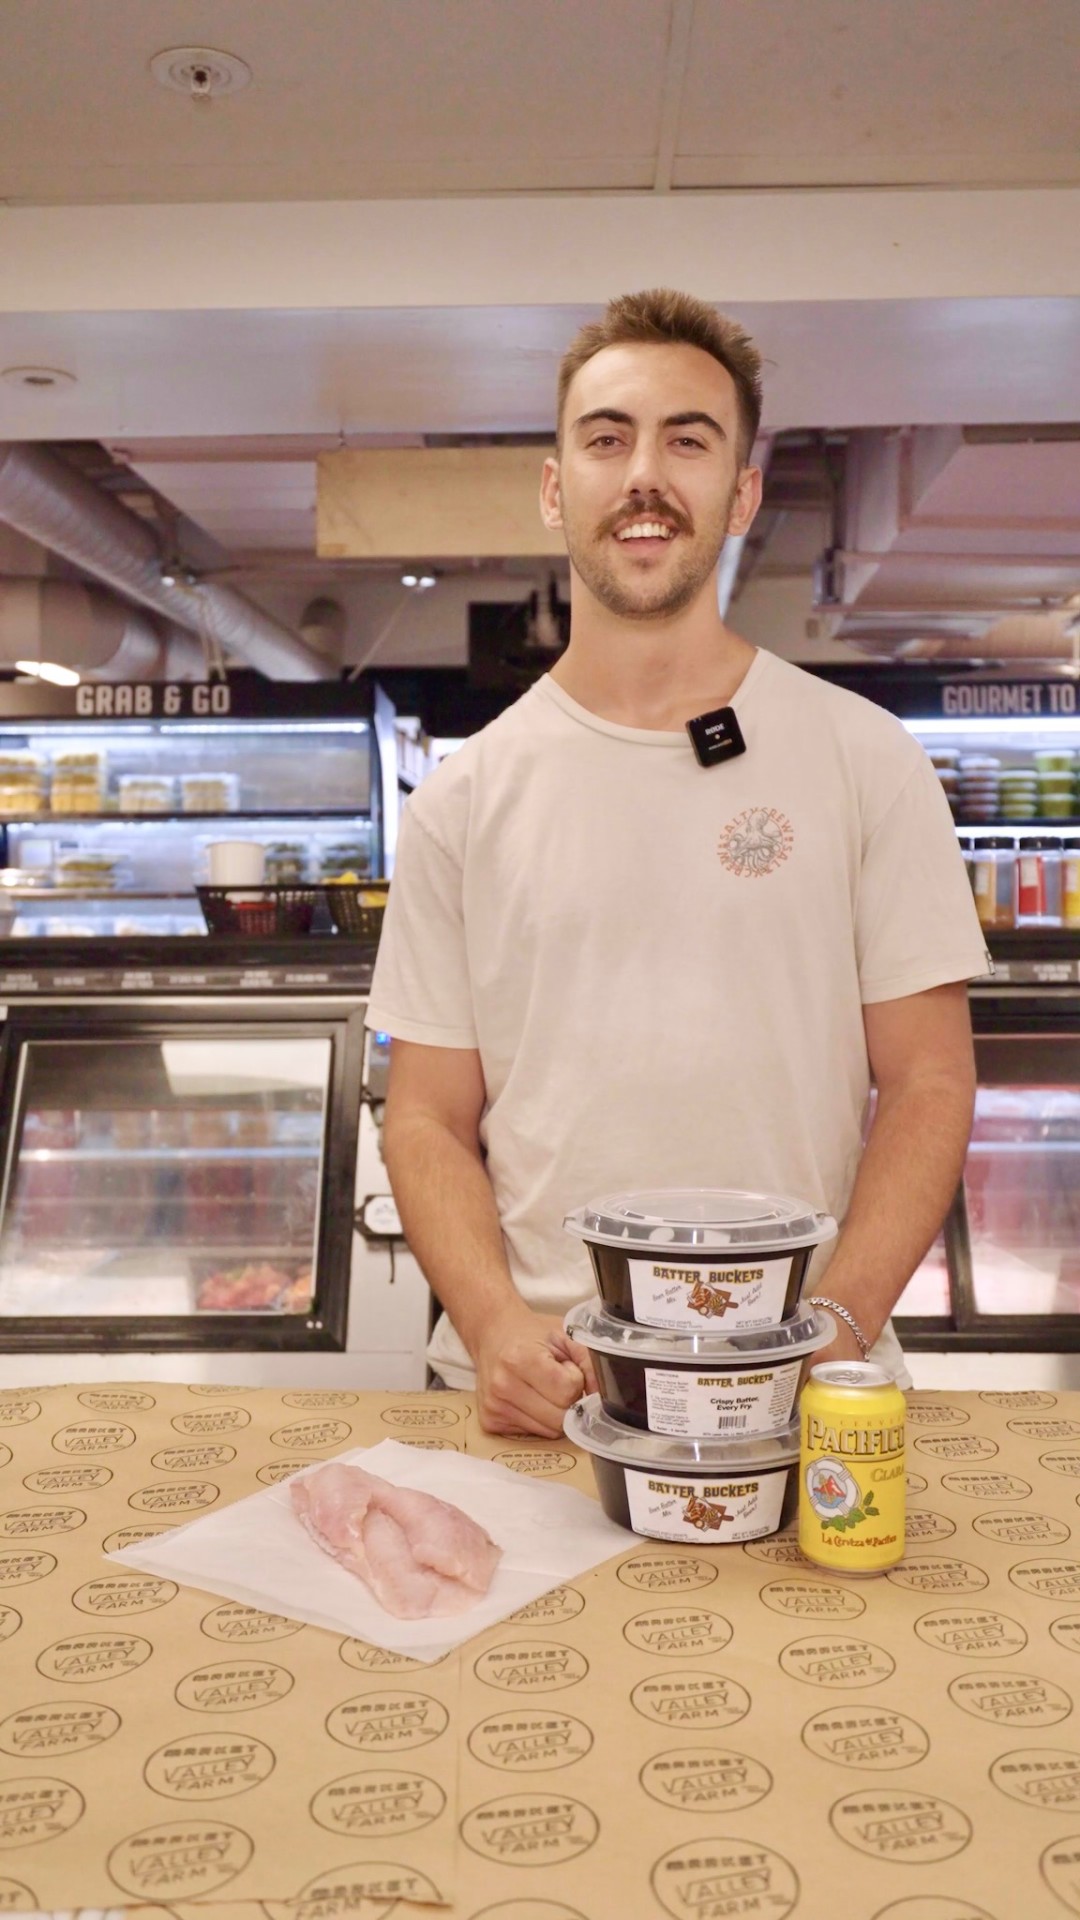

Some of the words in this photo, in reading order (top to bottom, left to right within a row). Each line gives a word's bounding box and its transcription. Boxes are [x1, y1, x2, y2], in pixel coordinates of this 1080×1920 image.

[76, 685, 153, 715] GRAB
[164, 685, 181, 714] &
[192, 685, 231, 714] GO
[942, 685, 1041, 714] GOURMET
[1047, 683, 1076, 713] TO
[653, 1266, 701, 1284] BATTER
[709, 1269, 763, 1284] BUCKETS
[697, 1378, 733, 1388] BATTER
[737, 1373, 773, 1386] BUCKETS
[142, 1485, 208, 1494] MARKET
[648, 1480, 695, 1498] BATTER
[703, 1482, 759, 1498] BUCKETS
[4, 1516, 73, 1531] VALLEY
[10, 1525, 54, 1534] FARM
[628, 1560, 698, 1569] MARKET
[894, 1563, 962, 1572] MARKET
[633, 1566, 700, 1584] VALLEY
[904, 1571, 968, 1586] VALLEY
[89, 1581, 166, 1589] MARKET
[648, 1578, 691, 1588] FARM
[770, 1586, 841, 1595] MARKET
[921, 1581, 964, 1590] FARM
[88, 1588, 162, 1604] VALLEY
[778, 1596, 846, 1608] VALLEY
[96, 1600, 144, 1610] FARM
[796, 1606, 840, 1614] FARM
[634, 1615, 711, 1626] MARKET
[924, 1616, 999, 1627] MARKET
[641, 1624, 713, 1644] VALLEY
[934, 1624, 1005, 1644] VALLEY
[56, 1640, 139, 1651] MARKET
[657, 1639, 704, 1650] FARM
[790, 1644, 869, 1656] MARKET
[955, 1640, 1000, 1651] FARM
[54, 1648, 136, 1670] VALLEY
[488, 1650, 570, 1662] MARKET
[62, 1663, 114, 1676] FARM
[493, 1660, 570, 1680] VALLEY
[799, 1654, 872, 1676] VALLEY
[192, 1670, 278, 1682] MARKET
[506, 1674, 556, 1686] FARM
[818, 1670, 867, 1682] FARM
[194, 1678, 276, 1702] VALLEY
[644, 1682, 726, 1692] MARKET
[958, 1680, 1040, 1690] MARKET
[204, 1694, 257, 1707] FARM
[341, 1700, 429, 1714] MARKET
[650, 1692, 729, 1713] VALLEY
[971, 1690, 1047, 1710] VALLEY
[15, 1711, 107, 1723] MARKET
[668, 1709, 719, 1721] FARM
[994, 1706, 1044, 1718] FARM
[345, 1710, 428, 1736] VALLEY
[483, 1720, 572, 1734] MARKET
[813, 1717, 901, 1732] MARKET
[13, 1720, 102, 1744] VALLEY
[358, 1730, 413, 1744] FARM
[20, 1736, 78, 1750] FARM
[488, 1730, 572, 1757] VALLEY
[824, 1728, 904, 1754] VALLEY
[163, 1745, 258, 1757] MARKET
[502, 1749, 558, 1764] FARM
[845, 1748, 898, 1762] FARM
[164, 1755, 256, 1784] VALLEY
[653, 1758, 744, 1770] MARKET
[175, 1776, 234, 1791] FARM
[328, 1780, 425, 1796] MARKET
[661, 1768, 748, 1794] VALLEY
[680, 1788, 739, 1803] FARM
[331, 1792, 423, 1821] VALLEY
[476, 1804, 575, 1820] MARKET
[842, 1801, 937, 1814] MARKET
[346, 1814, 406, 1828] FARM
[854, 1812, 944, 1841] VALLEY
[481, 1815, 576, 1846] VALLEY
[129, 1831, 235, 1848] MARKET
[499, 1838, 560, 1854] FARM
[878, 1836, 939, 1851] FARM
[129, 1842, 231, 1877] VALLEY
[666, 1854, 769, 1871] MARKET
[140, 1867, 207, 1888] FARM
[675, 1868, 773, 1906] VALLEY
[697, 1897, 762, 1920] FARM
